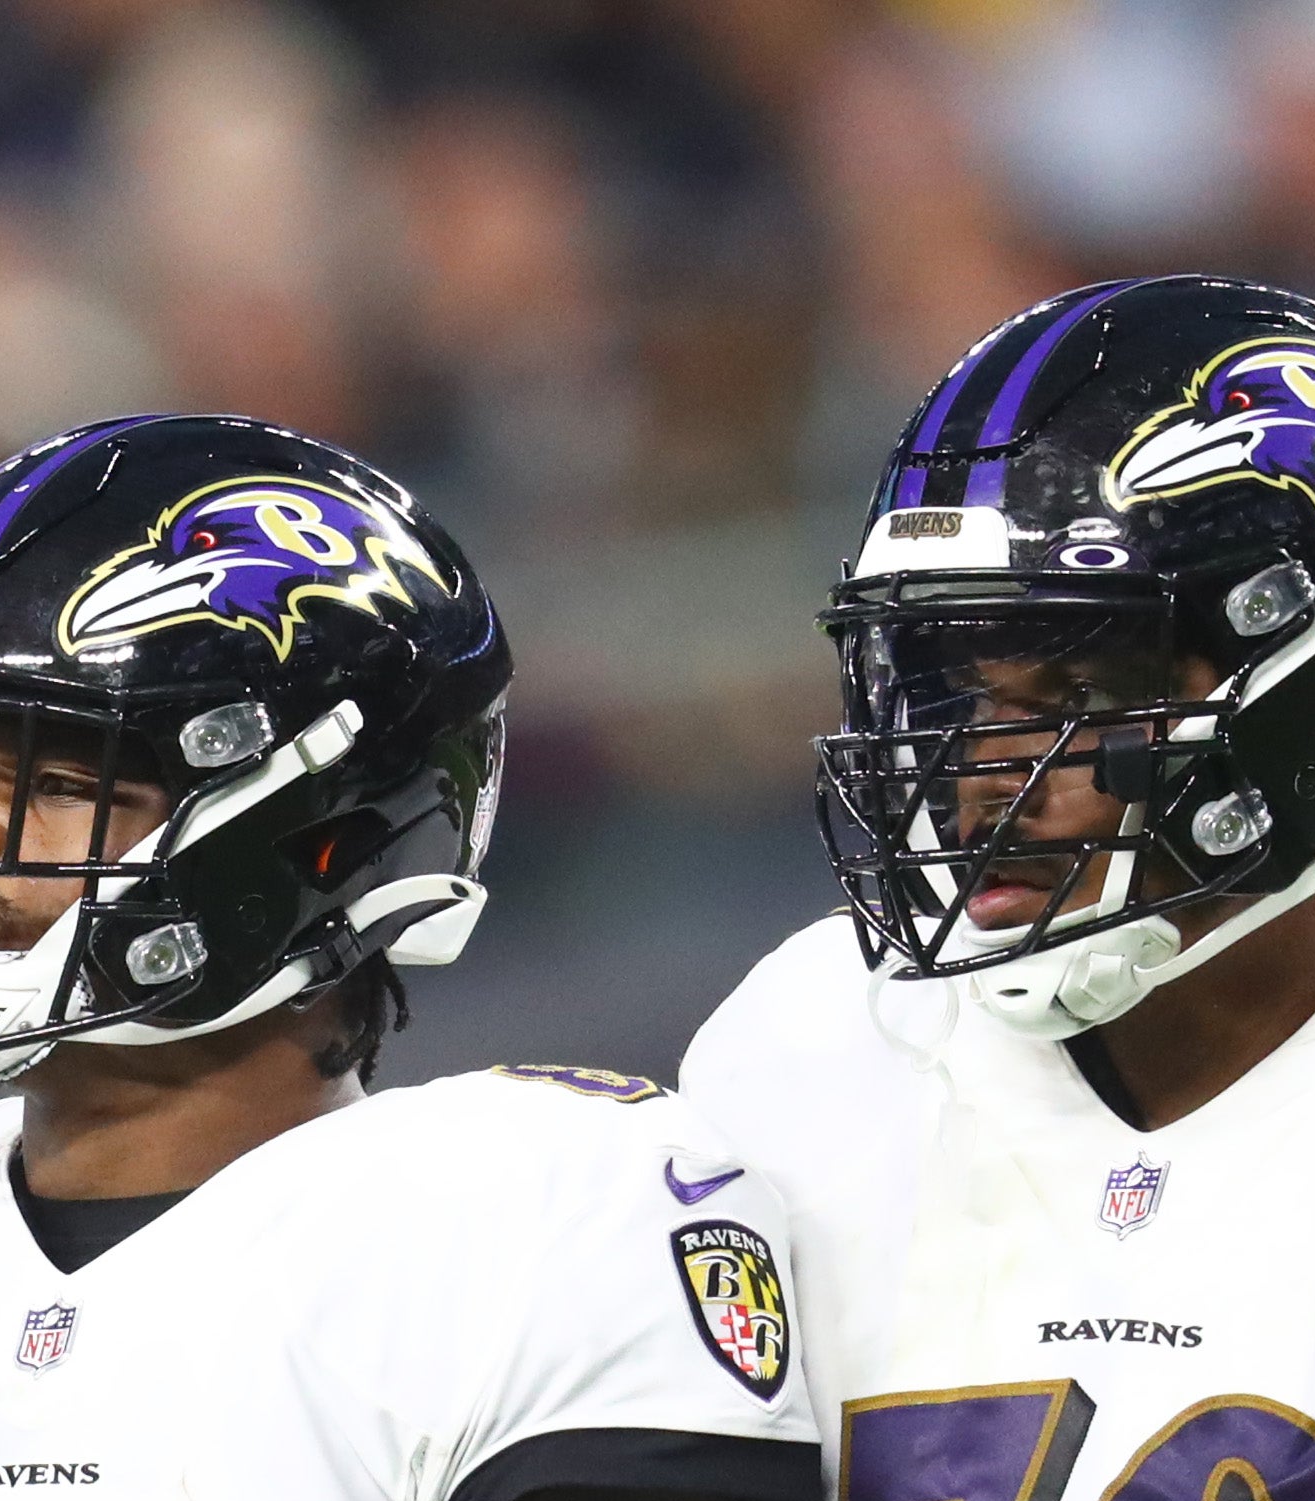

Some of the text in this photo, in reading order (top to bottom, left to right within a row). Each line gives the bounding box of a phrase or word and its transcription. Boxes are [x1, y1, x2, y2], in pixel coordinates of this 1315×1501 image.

[194, 490, 357, 566] B
[1106, 1190, 1149, 1222] NFL
[679, 1228, 768, 1260] RAVENS
[688, 1252, 742, 1301] B
[22, 1331, 65, 1363] NFL
[748, 1312, 783, 1364] R
[1037, 1318, 1204, 1349] RAVENS
